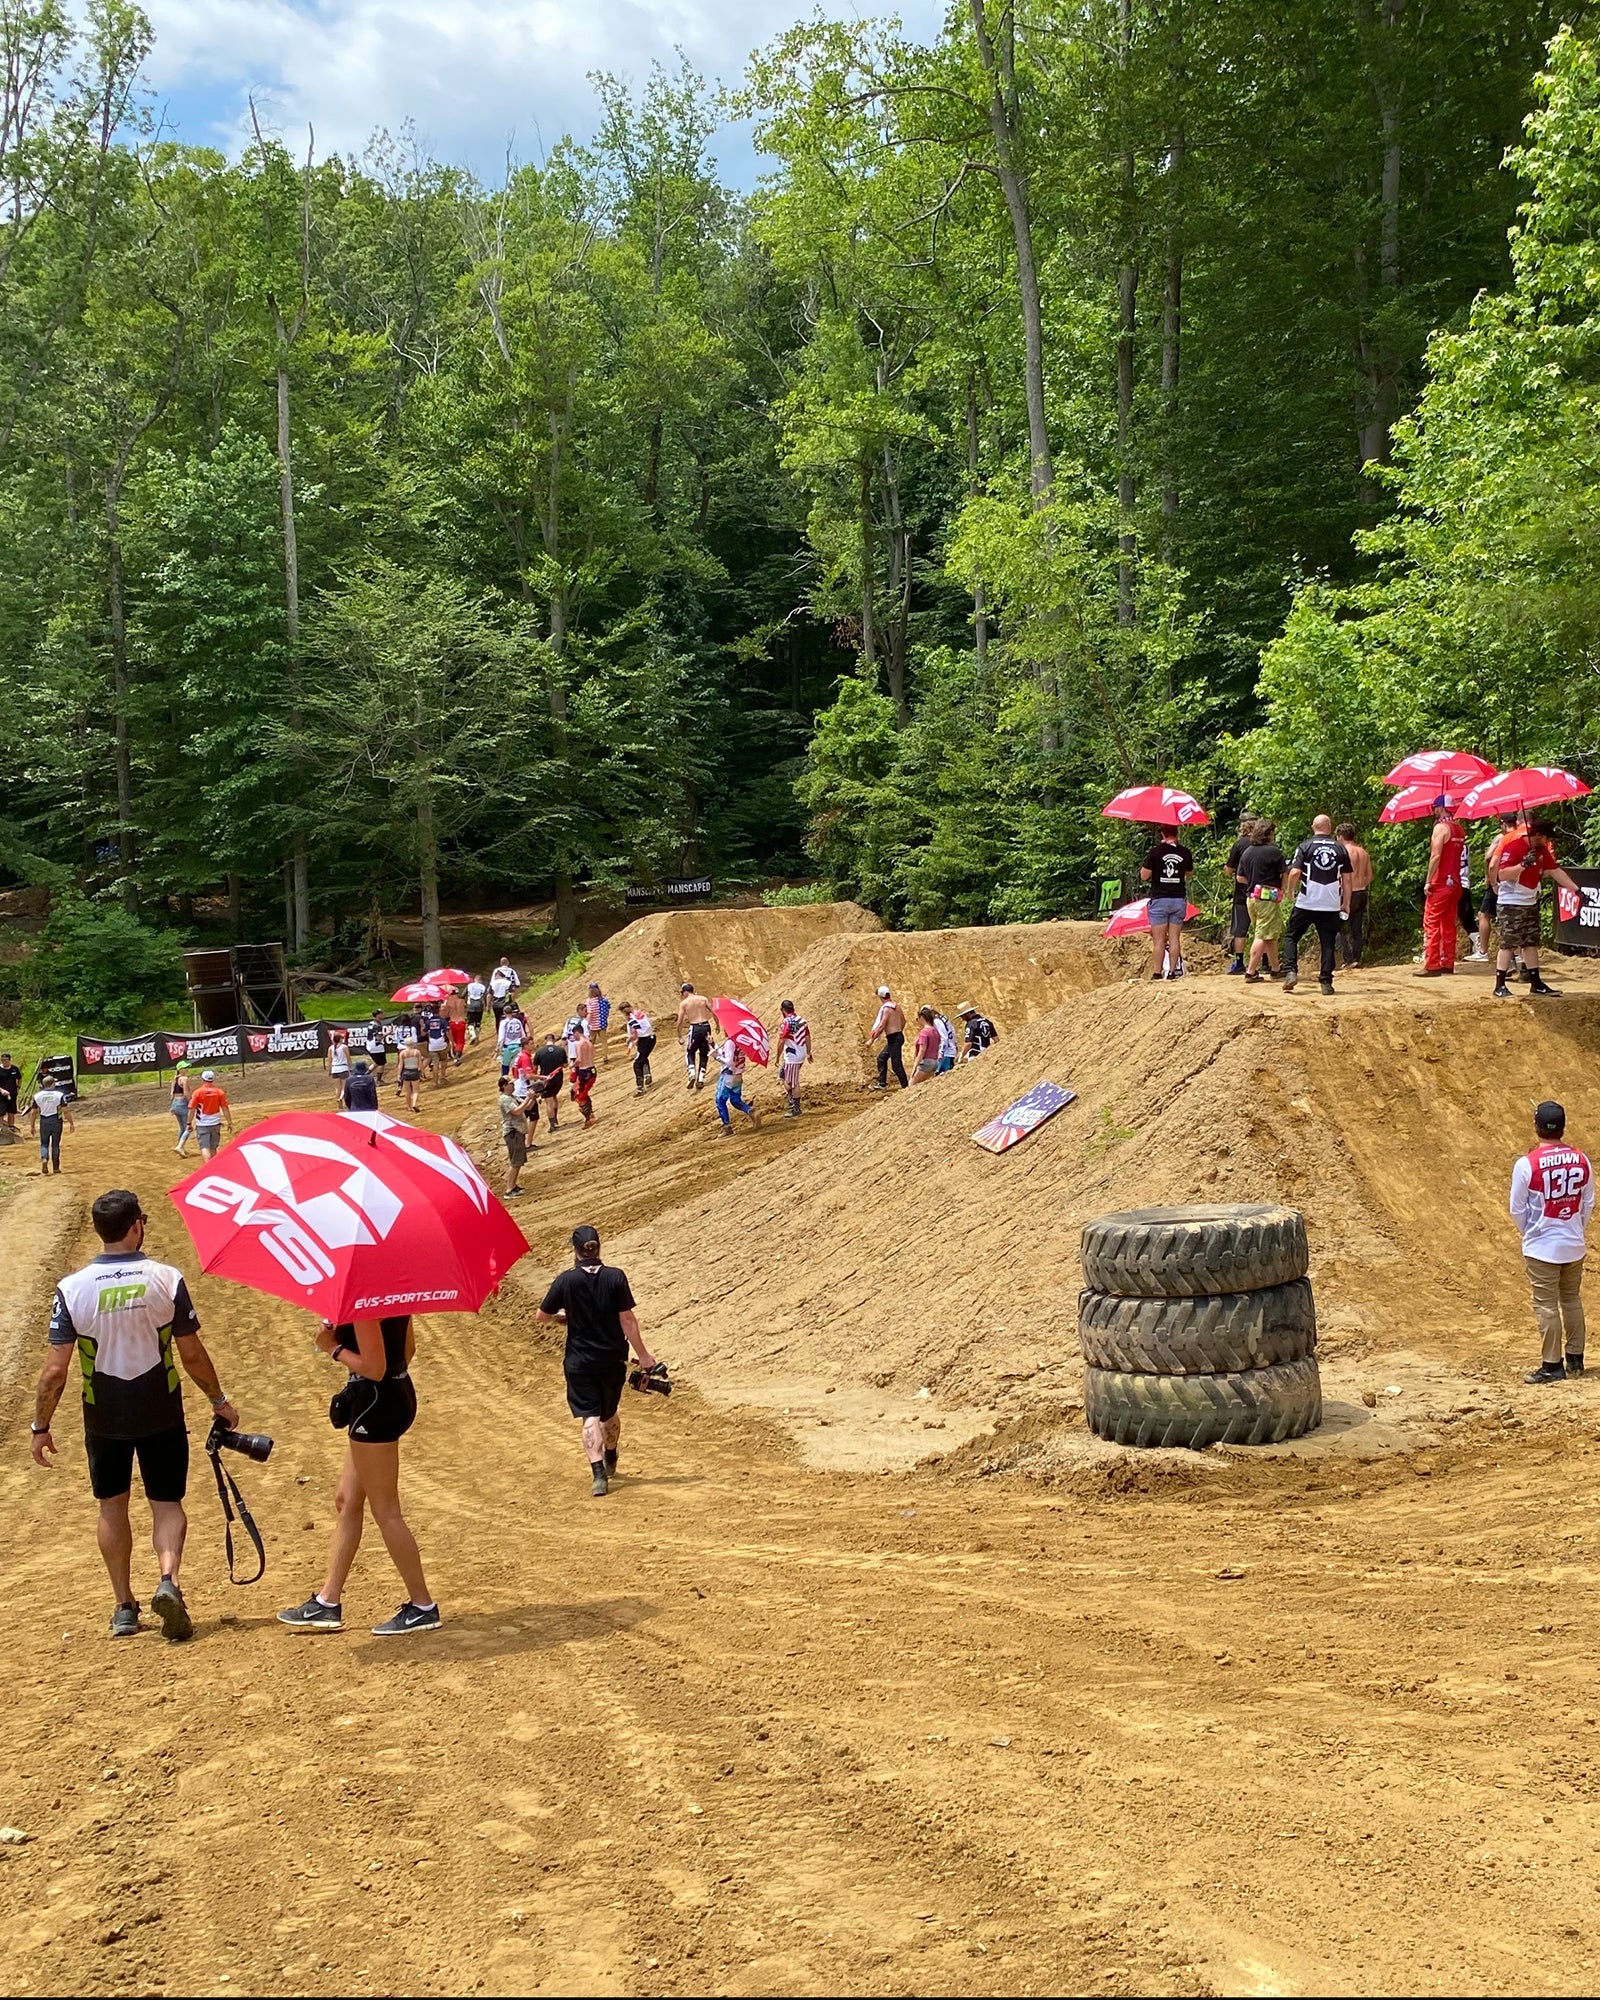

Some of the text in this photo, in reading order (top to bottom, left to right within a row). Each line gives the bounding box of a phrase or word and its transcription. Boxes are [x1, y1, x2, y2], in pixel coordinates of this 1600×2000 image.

[667, 881, 711, 894] MANSCAPED
[1560, 887, 1579, 916] TSC
[103, 1042, 156, 1056] TRACTOR
[166, 1042, 184, 1056] TSC
[186, 1035, 238, 1049] TRACTOR
[249, 1035, 267, 1049] TSC
[267, 1041, 307, 1053] SUPPLY
[84, 1047, 101, 1061] TSC
[103, 1053, 144, 1066] SUPPLY
[186, 1046, 226, 1059] SUPPLY
[1539, 1153, 1580, 1169] BROWN
[1542, 1166, 1584, 1200] 132
[354, 1289, 458, 1310] EVS-SPORTS.COM
